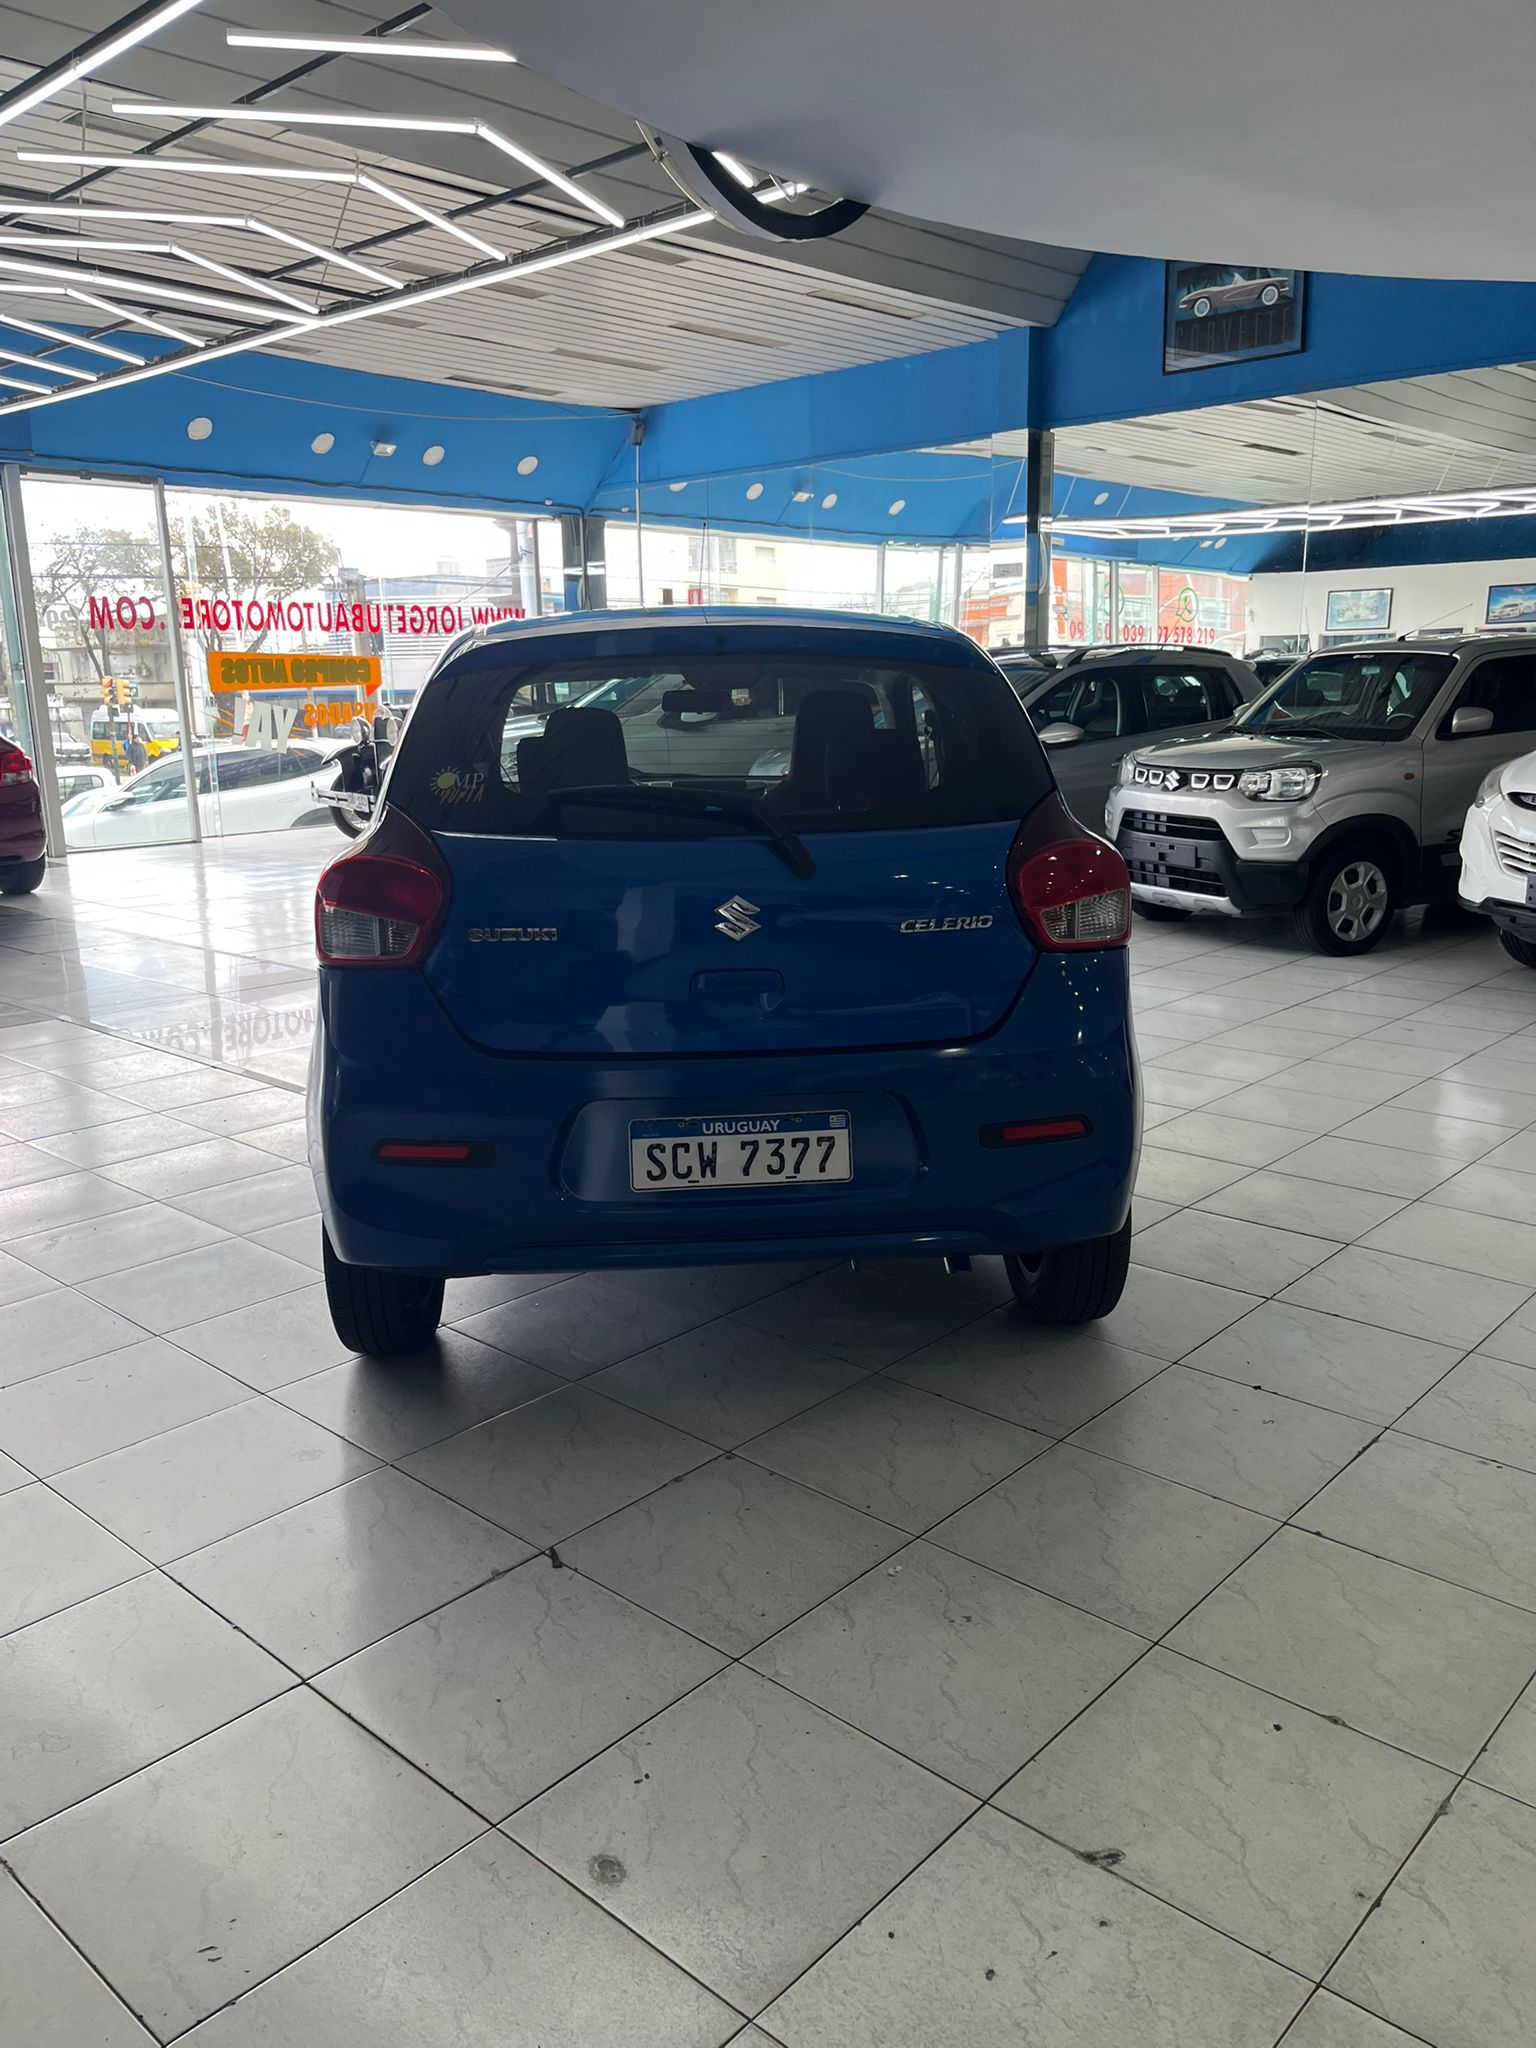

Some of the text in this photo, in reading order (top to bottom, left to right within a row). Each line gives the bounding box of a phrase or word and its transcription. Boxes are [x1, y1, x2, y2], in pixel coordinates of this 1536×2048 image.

[1173, 626, 1193, 643] 578
[1197, 627, 1215, 644] 219
[900, 915, 993, 933] CELERIO
[468, 927, 558, 942] SUZUKI
[702, 1119, 781, 1135] URUGUAY
[646, 1136, 836, 1182] SCW 7377
